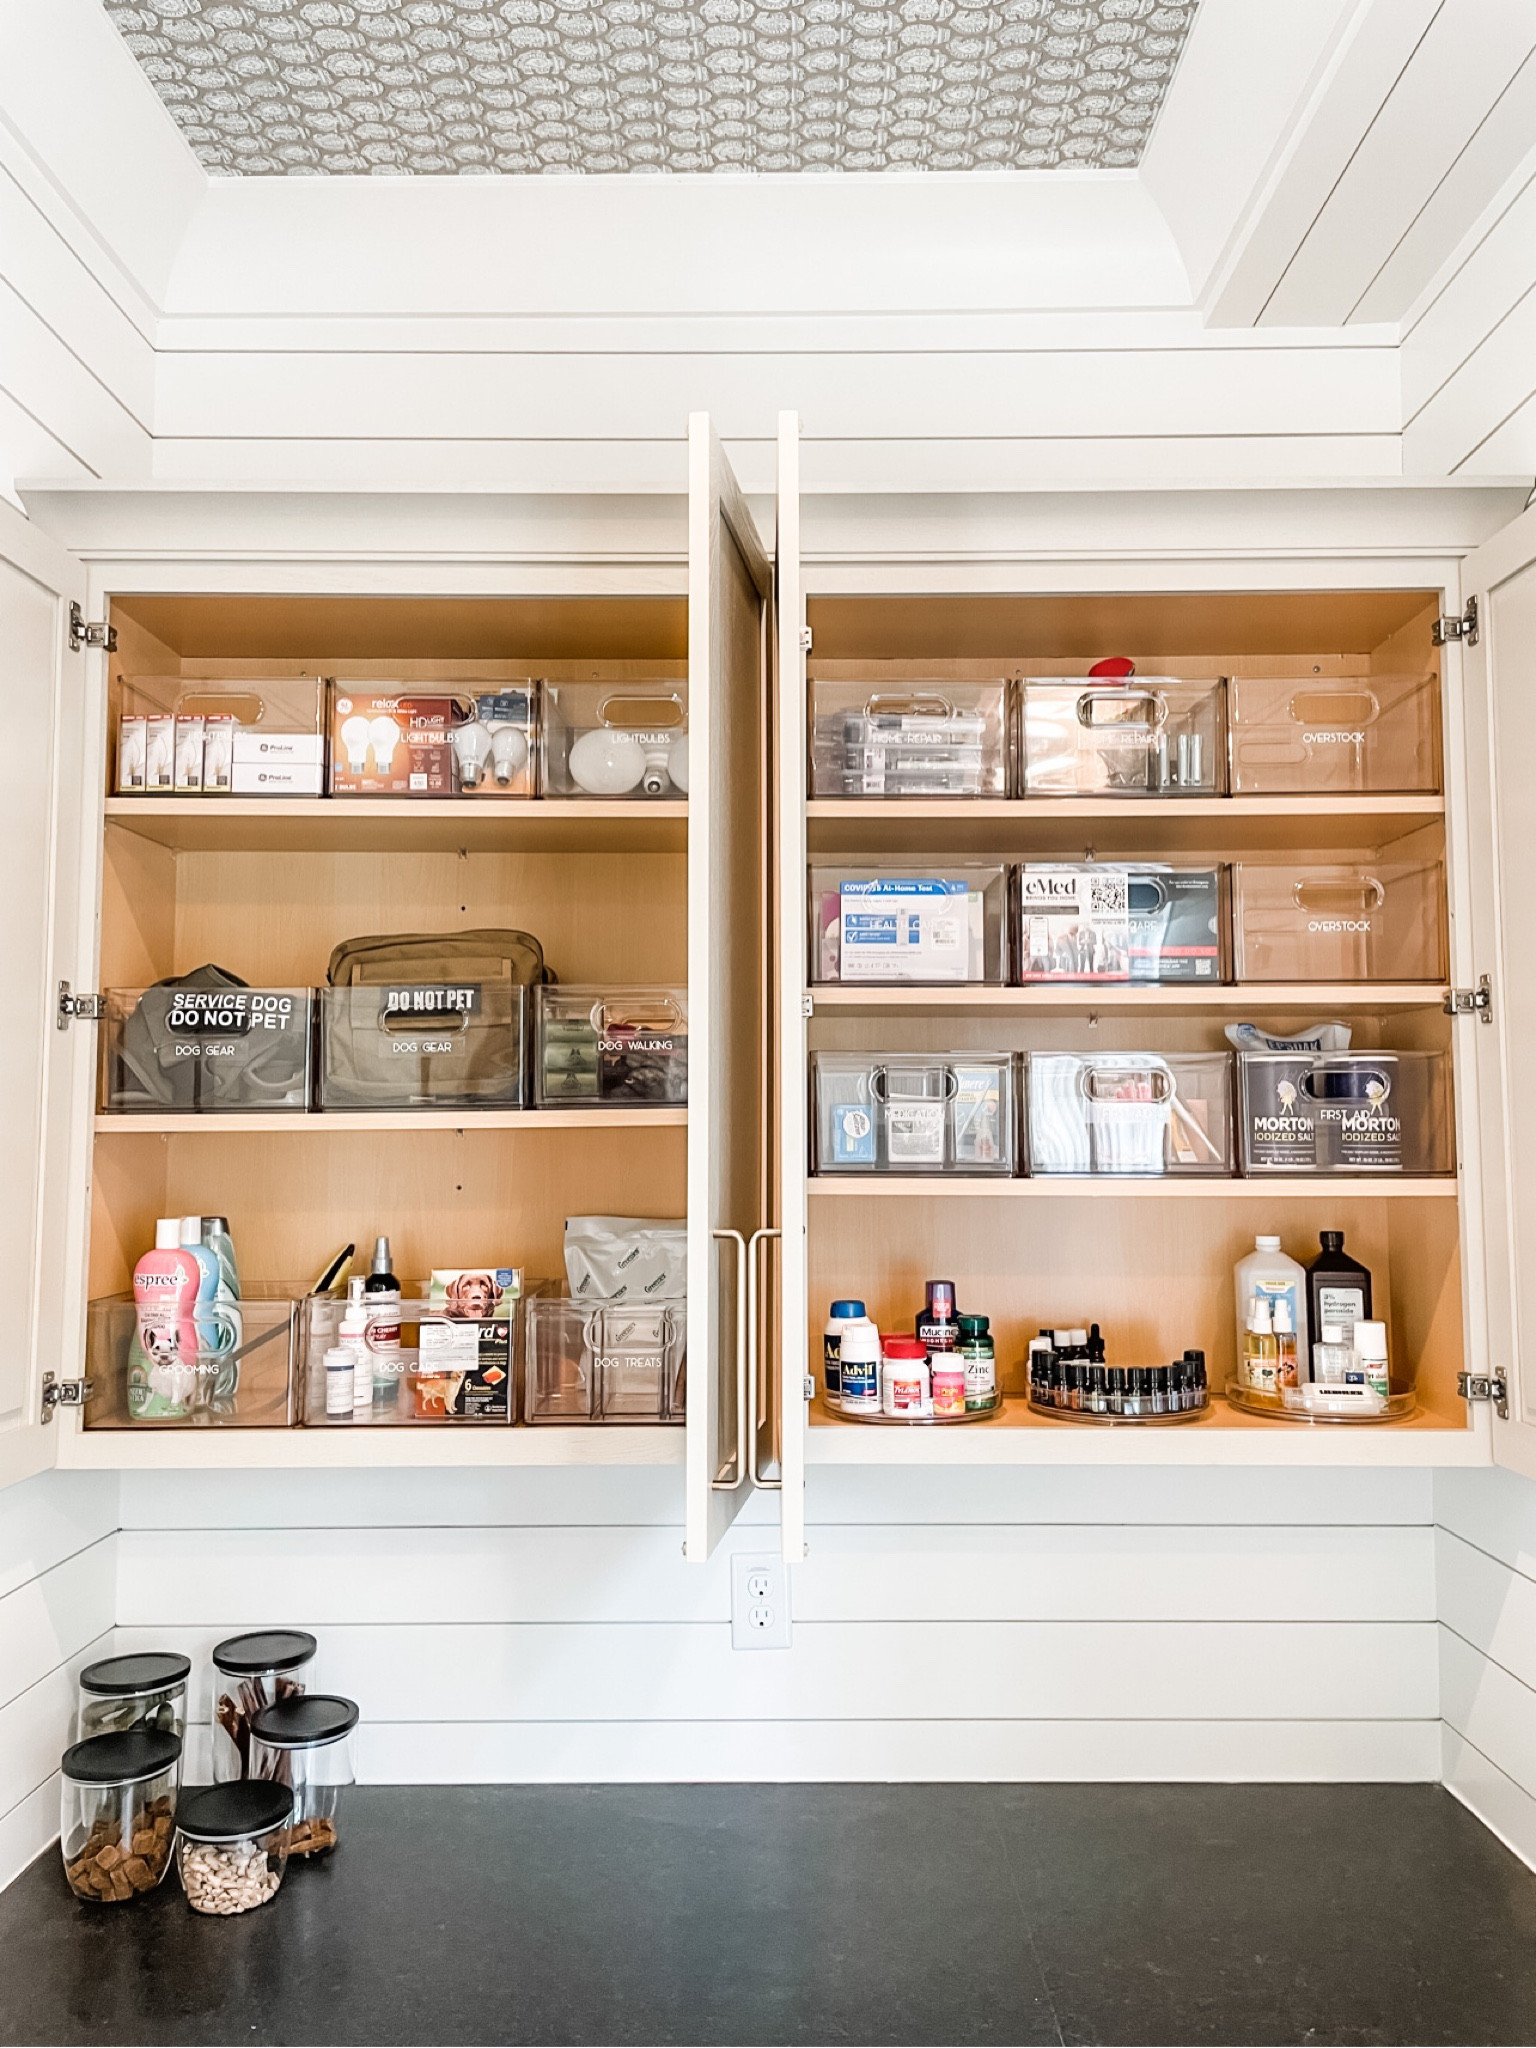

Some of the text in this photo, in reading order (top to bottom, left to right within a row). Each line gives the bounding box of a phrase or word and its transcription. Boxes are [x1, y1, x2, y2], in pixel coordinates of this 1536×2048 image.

[400, 732, 460, 744] LIGHTBULBS
[611, 731, 671, 744] LIGHTBULBS
[872, 733, 943, 744] HOME REPAIR
[1120, 734, 1157, 745] REPAIR
[1302, 731, 1365, 744] OVERSTOCK
[918, 883, 933, 893] Test
[1025, 878, 1076, 895] eMed
[1308, 920, 1371, 932] OVERSTOCK
[172, 993, 292, 1013] SERVICE DOG
[388, 988, 475, 1011] DO NOT PET
[171, 1010, 290, 1030] DO NOT PET
[175, 1045, 235, 1056] DOG GEAR
[392, 1041, 452, 1053] DOG GEAR
[598, 1040, 673, 1051] DOG WALKING
[1320, 1109, 1370, 1120] FIRST AID
[1254, 1116, 1314, 1131] MORTON
[1341, 1117, 1401, 1131] MORTON
[1254, 1132, 1296, 1141] IODIZED
[1341, 1132, 1385, 1141] IODIZED
[134, 1274, 178, 1290] espree
[1323, 1301, 1356, 1309] hydrogen
[379, 1362, 405, 1373] DOG
[594, 1357, 662, 1368] DOG TREATS
[158, 1364, 220, 1374] GROOMING
[842, 1363, 875, 1376] Advil
[968, 1364, 989, 1374] Zinc
